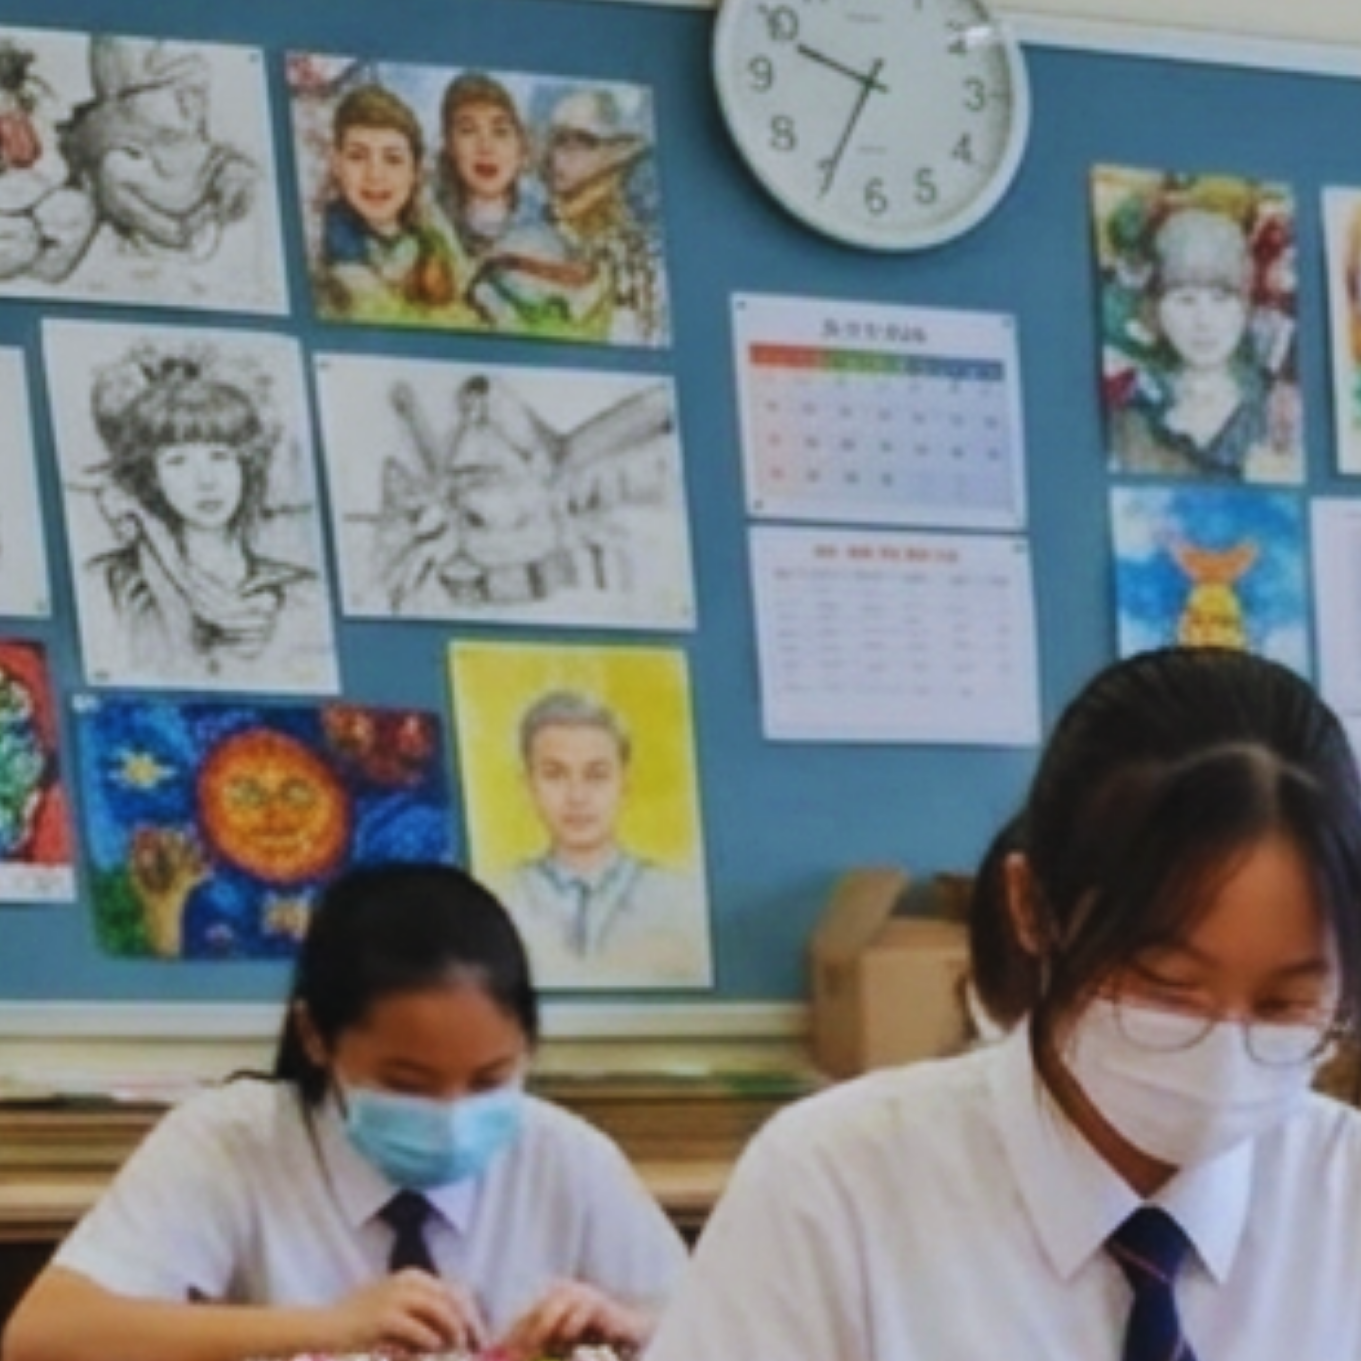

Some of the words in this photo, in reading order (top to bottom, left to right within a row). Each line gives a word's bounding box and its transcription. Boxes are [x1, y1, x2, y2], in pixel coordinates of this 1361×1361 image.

[746, 55, 773, 93] 9
[962, 77, 987, 112] 3
[769, 115, 797, 151] 8
[952, 132, 973, 166] 4
[864, 177, 889, 215] 6
[915, 167, 939, 204] 5
